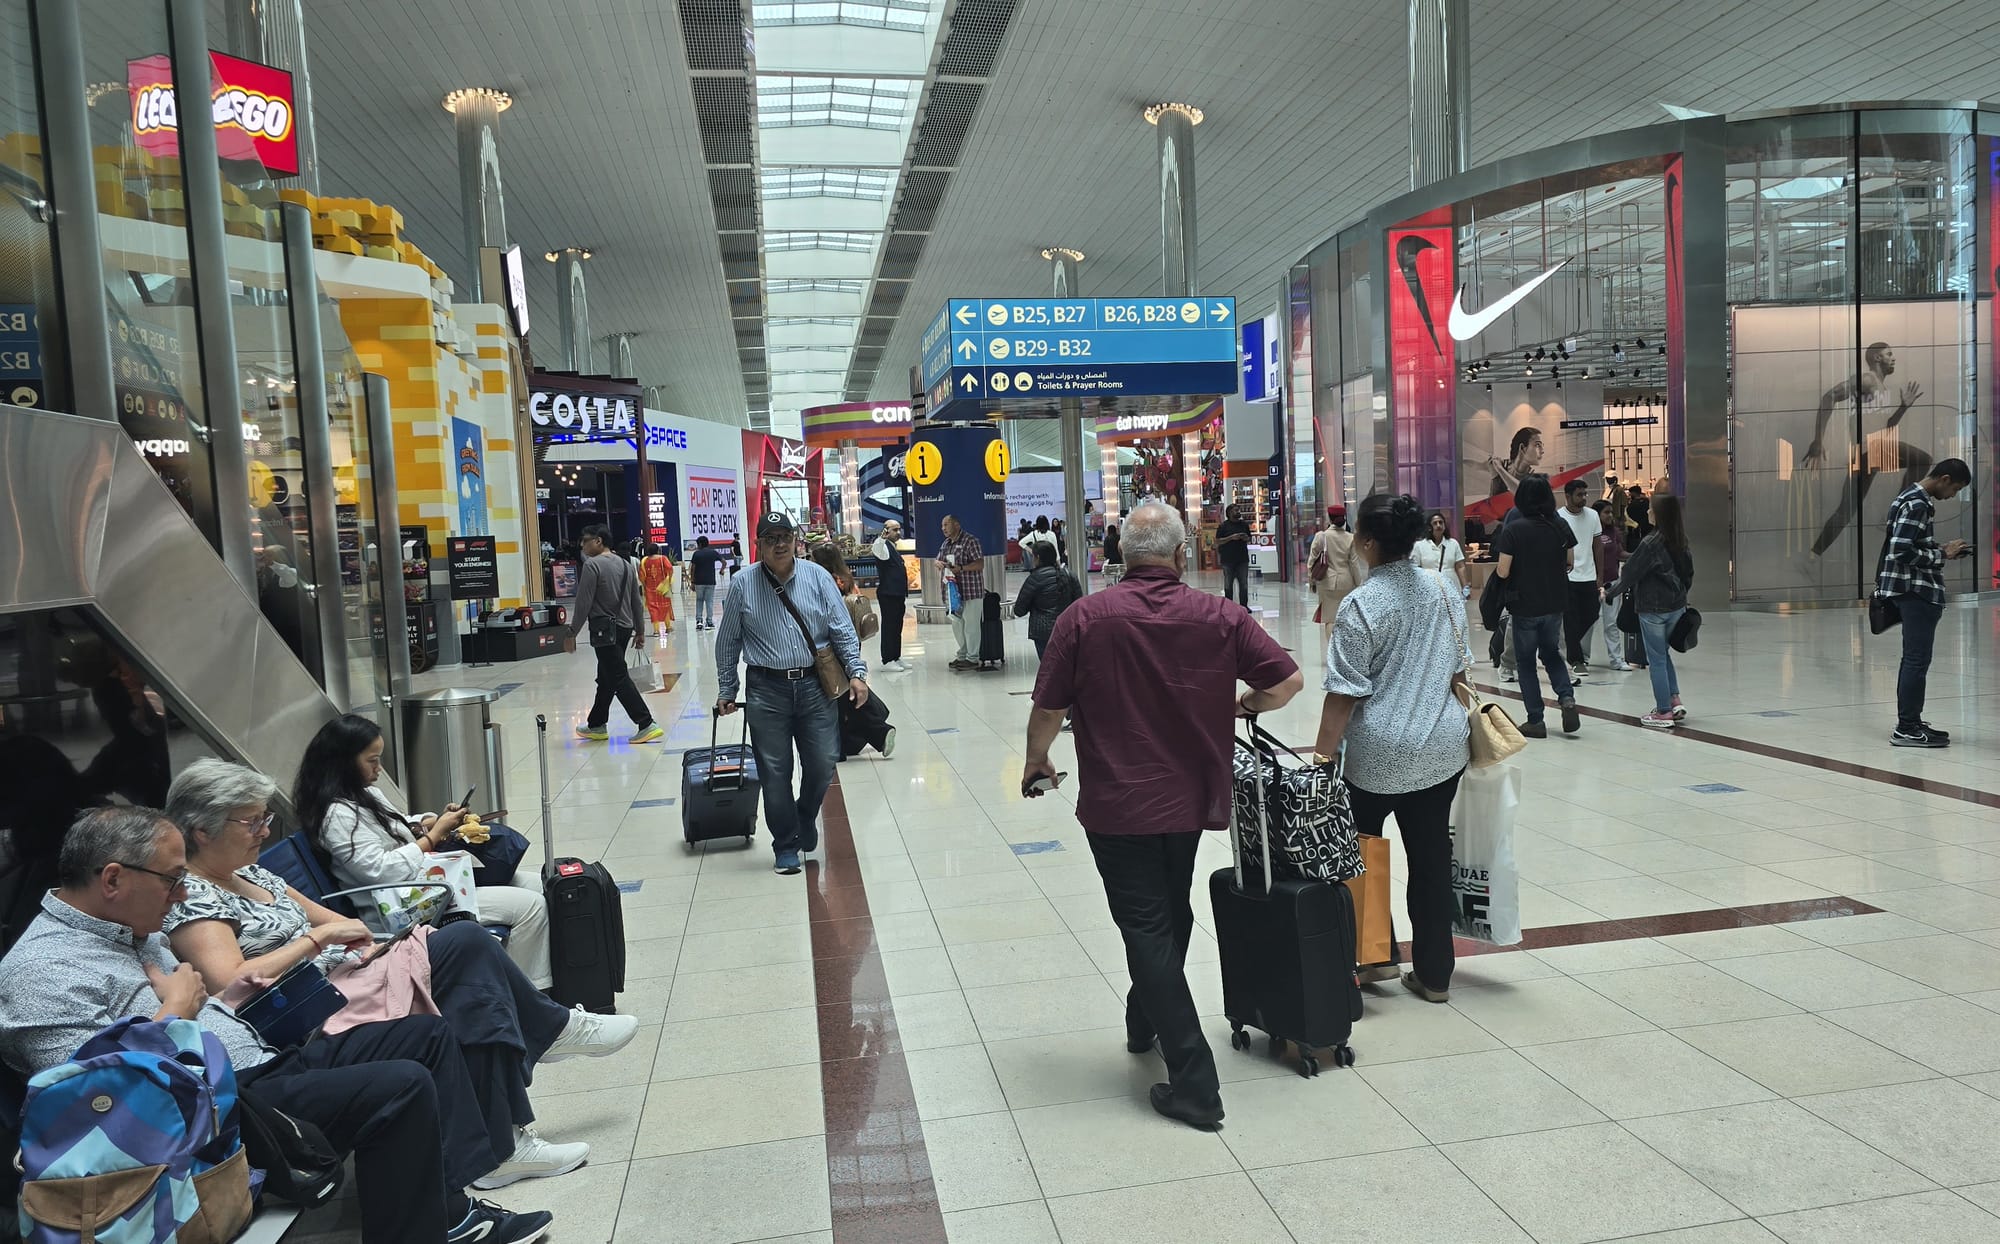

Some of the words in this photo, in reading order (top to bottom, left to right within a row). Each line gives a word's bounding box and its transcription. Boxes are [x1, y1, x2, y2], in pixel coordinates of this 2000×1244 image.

[1014, 306, 1050, 325] B25,
[1054, 306, 1086, 323] B27
[1104, 305, 1141, 325] B26,
[1144, 305, 1177, 322] B28
[1015, 340, 1048, 357] B29
[1059, 339, 1091, 356] B32
[1036, 372, 1055, 380] المياه
[1056, 372, 1075, 381] دورات
[1081, 371, 1108, 381] المصلى
[1037, 381, 1063, 390] Toilets
[1065, 381, 1071, 389] &
[1073, 381, 1096, 391] Prayer
[1098, 380, 1123, 389] Rooms
[530, 391, 632, 434] COSTA
[871, 405, 910, 425] can
[1133, 414, 1169, 431] happy
[651, 426, 687, 449] SPACE
[690, 487, 711, 508] PLAY
[712, 489, 725, 511] PC,
[726, 489, 736, 508] VR
[692, 514, 708, 534] PS5
[710, 515, 716, 533] &
[718, 514, 738, 533] XBOX
[1460, 869, 1489, 881] UAE
